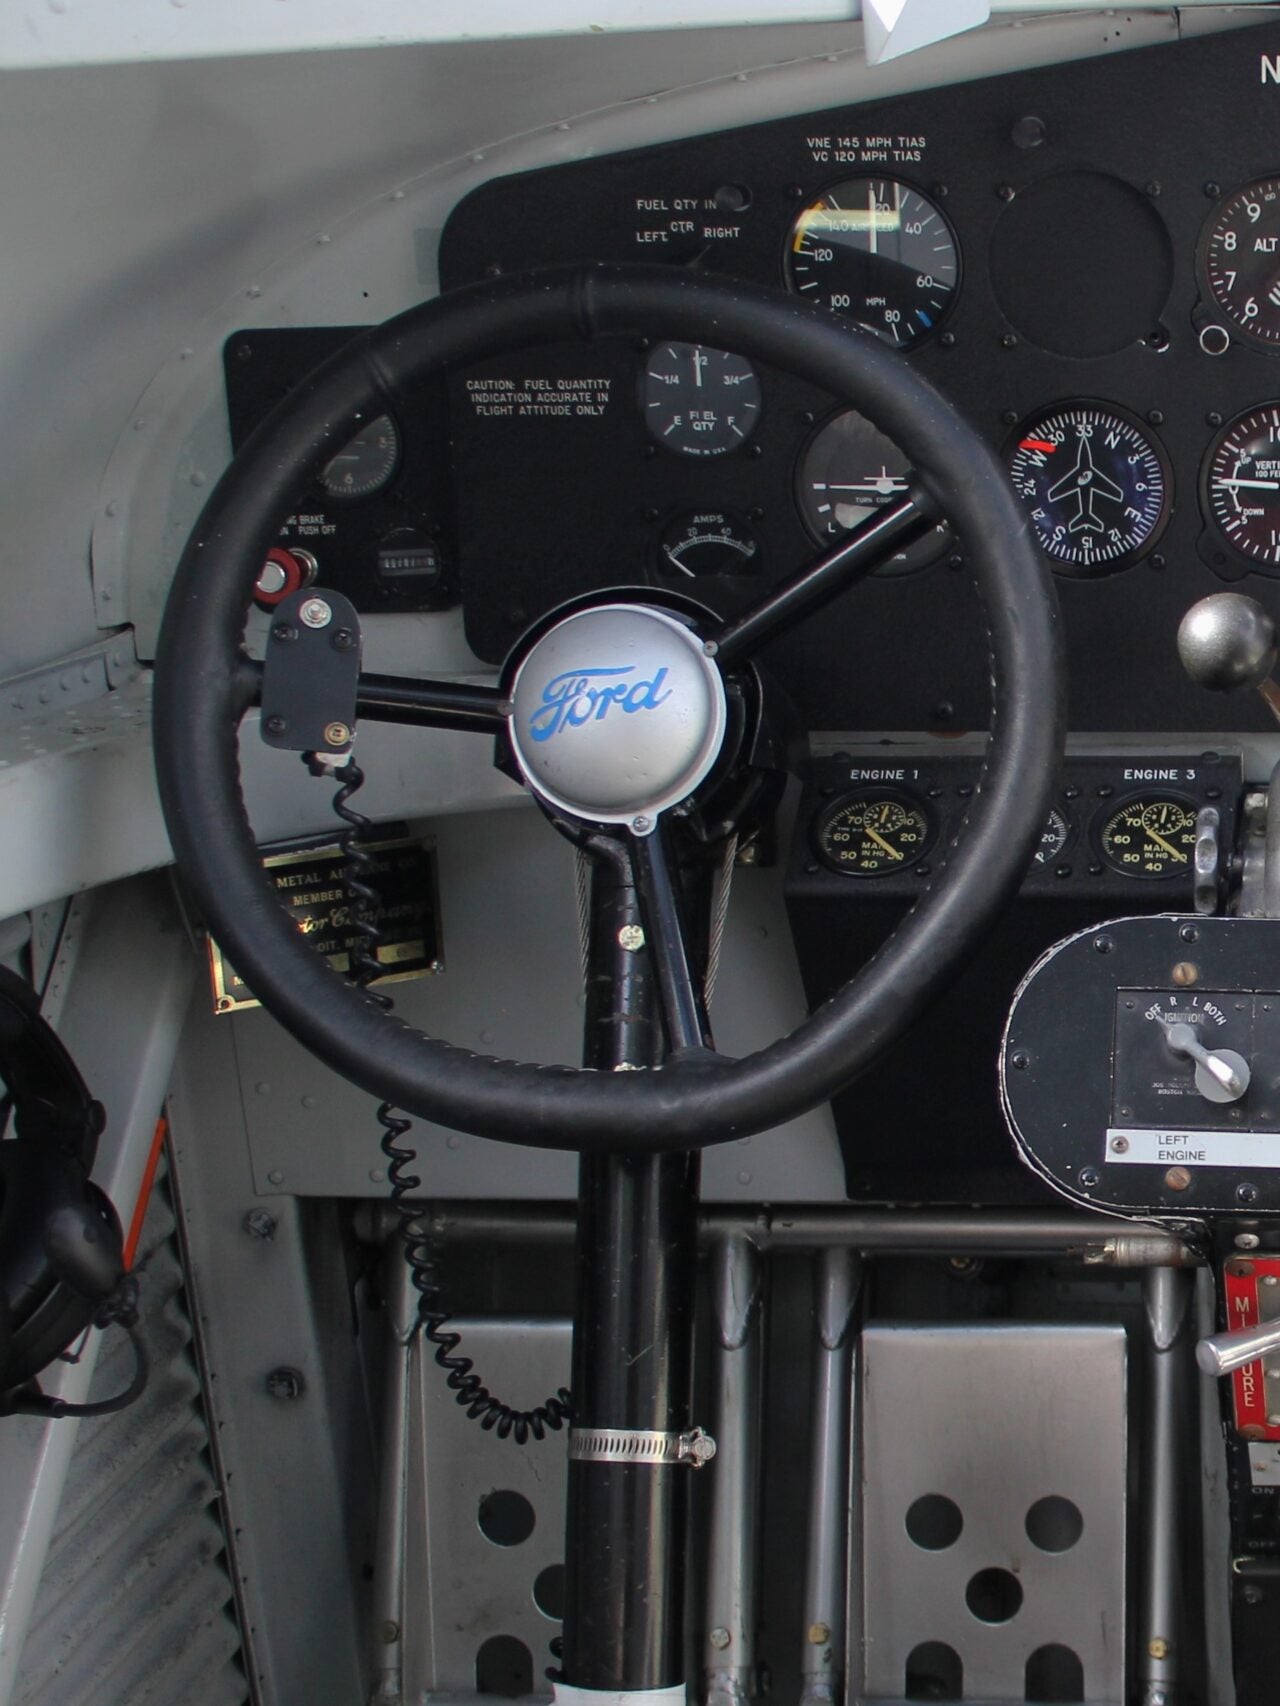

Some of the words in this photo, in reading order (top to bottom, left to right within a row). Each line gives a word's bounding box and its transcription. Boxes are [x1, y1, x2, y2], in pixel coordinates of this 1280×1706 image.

[807, 137, 832, 149] VNE
[837, 137, 860, 149] 145
[865, 137, 894, 149] MPH
[897, 136, 927, 148] TIAS
[812, 151, 830, 163] VC
[834, 151, 856, 163] 120
[861, 151, 888, 163] MPH
[893, 150, 922, 162] TIAS
[636, 200, 669, 211] FUEL
[673, 200, 699, 212] QTY
[1246, 202, 1262, 224] 9
[670, 221, 695, 234] CTR
[703, 227, 741, 239] RIGHT
[905, 222, 923, 235] 40
[636, 231, 669, 243] LEFT
[1224, 231, 1237, 251] 8
[1253, 237, 1279, 253] ALT
[814, 249, 834, 262] 120
[916, 275, 934, 289] 60
[1224, 271, 1237, 292] 7
[830, 294, 851, 308] 100
[866, 296, 887, 307] MPH
[1244, 296, 1259, 317] 6
[884, 309, 901, 324] 80
[466, 379, 516, 391] CAUTION:
[524, 379, 553, 391] FUEL
[557, 379, 612, 391] QUANTITY
[663, 375, 680, 386] 1/4
[723, 375, 741, 386] 3/4
[470, 393, 532, 403] INDICATION
[536, 392, 592, 403] ACCURATE
[597, 392, 609, 403] IN
[476, 405, 514, 416] FLIGHT
[519, 405, 572, 416] ATTITUDE
[576, 405, 605, 416] ONLY
[673, 415, 682, 426] E
[692, 421, 716, 432] QTY
[1104, 431, 1121, 450] N
[1240, 456, 1252, 465] UP
[1254, 469, 1269, 478] 100
[1123, 506, 1142, 523] E
[1242, 507, 1265, 517] DOWN
[298, 514, 326, 525] BRAKE
[693, 514, 725, 524] AMPS
[297, 525, 320, 536] PUSH
[321, 524, 337, 535] OFF
[1052, 525, 1067, 542] S
[529, 665, 673, 743] Ford
[850, 769, 905, 780] ENGINE
[912, 769, 920, 780] 1
[1123, 769, 1178, 780] ENGINE
[1186, 769, 1196, 780] 3
[1113, 835, 1131, 845] 60
[872, 849, 886, 857] HG
[1122, 853, 1140, 863] 50
[1155, 851, 1169, 860] HG
[1144, 862, 1163, 872] 40
[276, 873, 322, 889] METAL
[292, 889, 344, 907] MEMBER
[1144, 1002, 1163, 1022] OFF
[1169, 996, 1178, 1007] R
[1192, 996, 1199, 1007] L
[1203, 1001, 1228, 1027] BOTH
[1157, 1135, 1189, 1146] LEFT
[1158, 1150, 1206, 1161] ENGINE
[1251, 1485, 1275, 1496] ON
